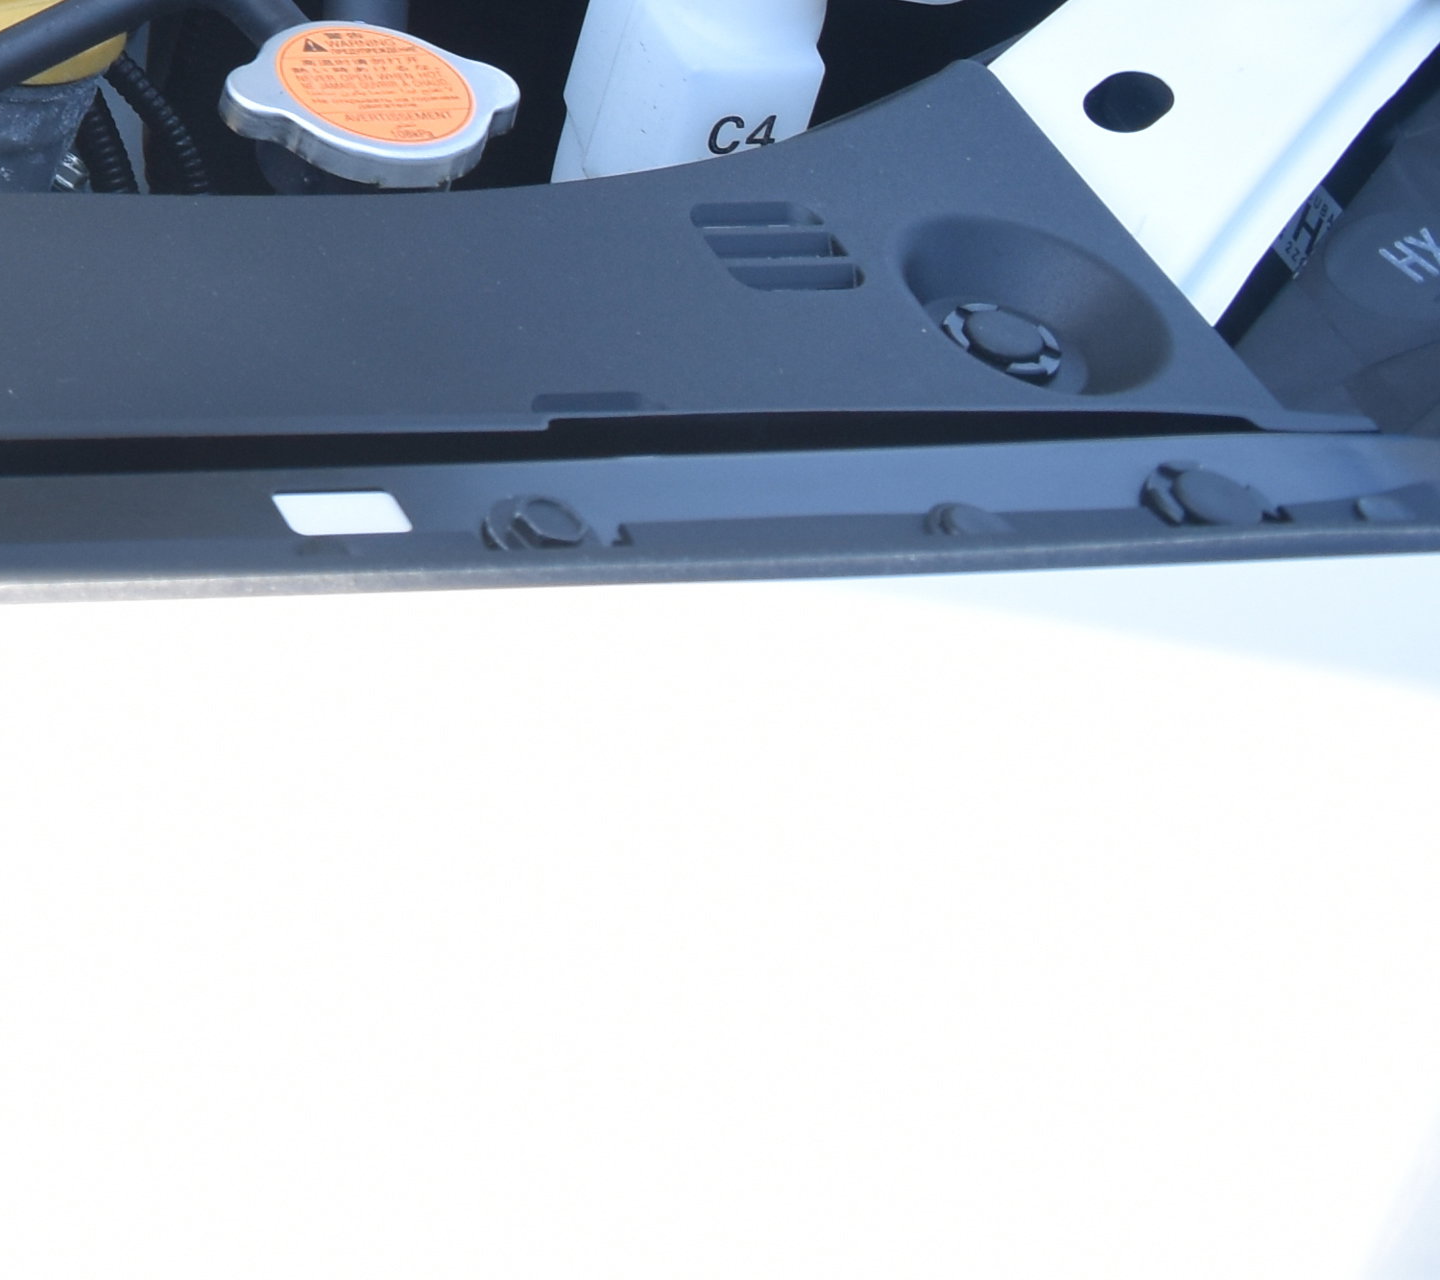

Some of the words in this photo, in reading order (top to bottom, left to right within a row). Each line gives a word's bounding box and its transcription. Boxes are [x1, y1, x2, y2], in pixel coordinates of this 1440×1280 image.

[324, 39, 396, 48] WARNING
[344, 112, 452, 122] AVERTISSEMENT
[708, 115, 777, 155] C4
[1293, 201, 1325, 256] H
